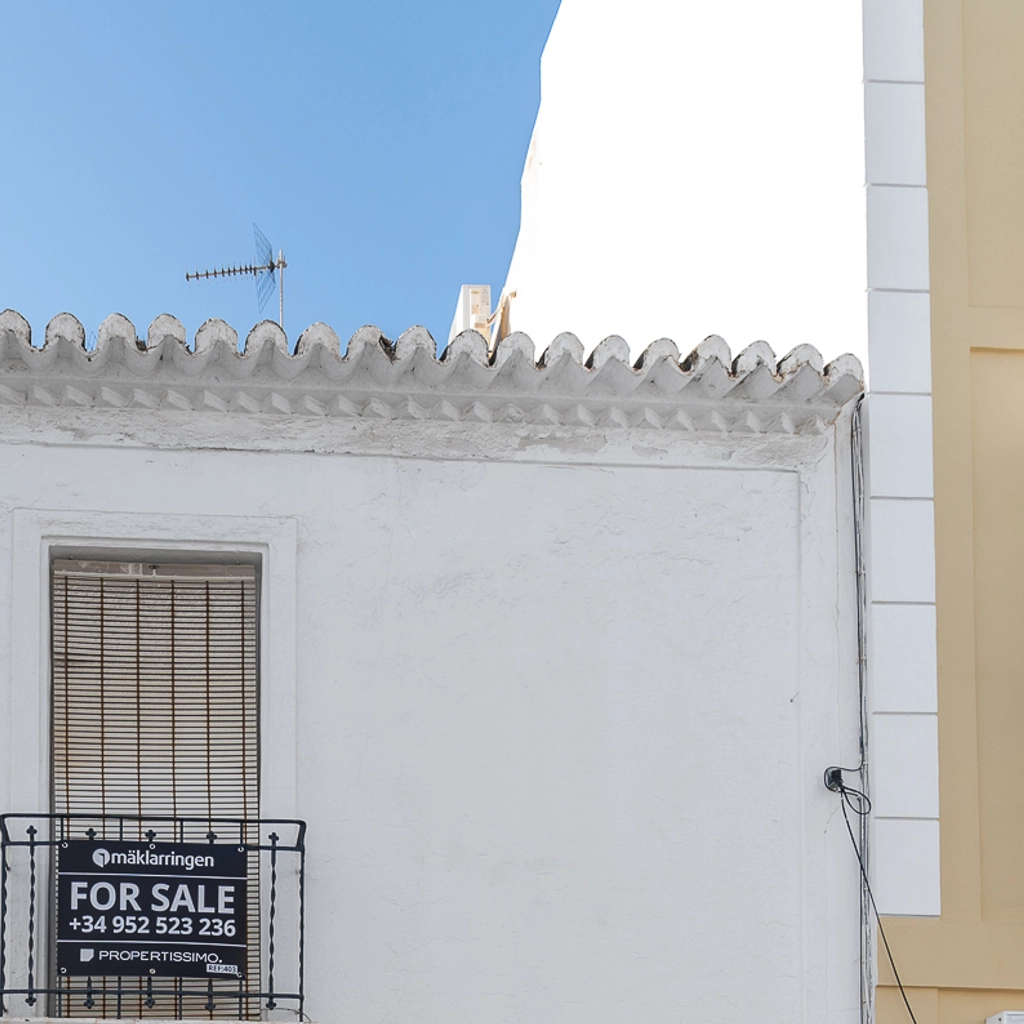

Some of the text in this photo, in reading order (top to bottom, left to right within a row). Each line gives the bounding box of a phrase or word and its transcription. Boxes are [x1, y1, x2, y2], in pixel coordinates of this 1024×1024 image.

[111, 850, 215, 870] mäklarringen
[70, 881, 235, 914] FOR SALE
[69, 915, 236, 937] +34 952 523 236
